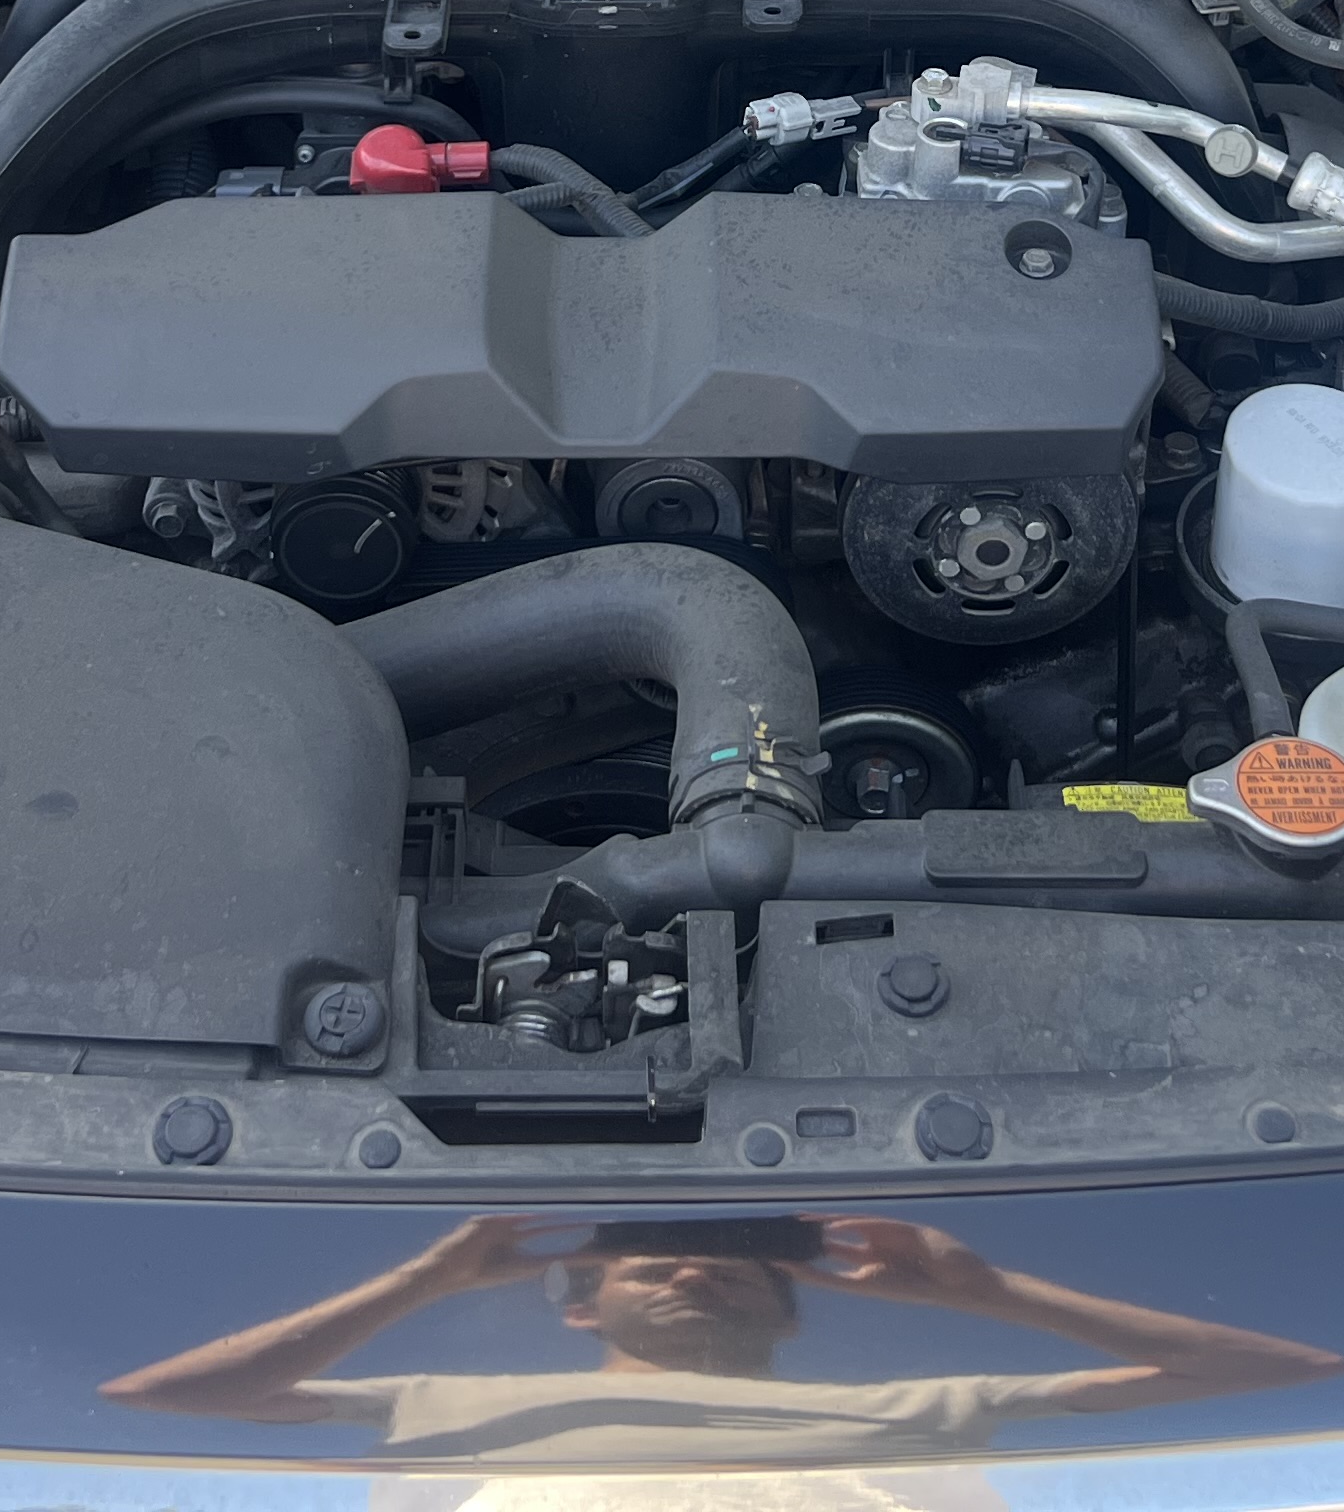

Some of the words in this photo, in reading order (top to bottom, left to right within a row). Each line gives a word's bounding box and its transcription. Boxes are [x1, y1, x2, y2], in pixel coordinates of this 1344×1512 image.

[1213, 138, 1247, 169] H
[1275, 757, 1333, 770] WARNING
[1110, 786, 1150, 795] CAUTION
[1247, 785, 1274, 795] NEVER
[1277, 785, 1299, 795] OPEN
[1303, 785, 1327, 794] WHEN
